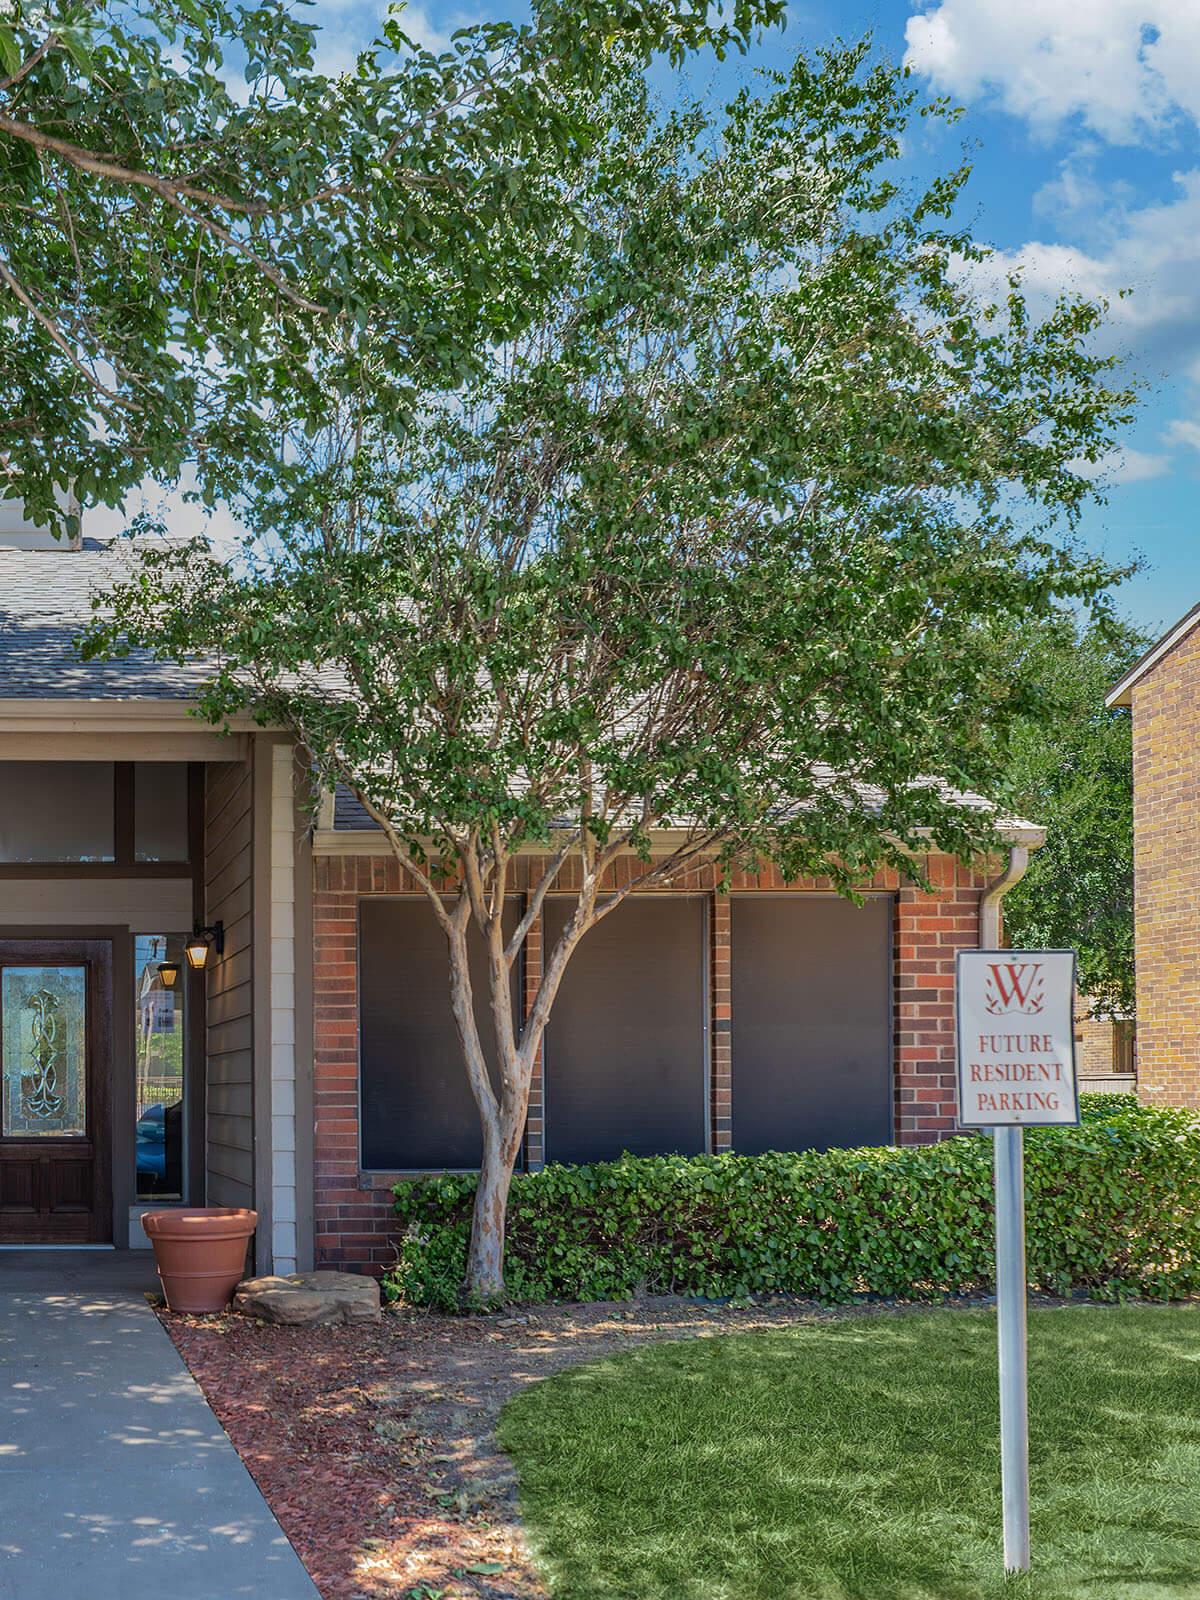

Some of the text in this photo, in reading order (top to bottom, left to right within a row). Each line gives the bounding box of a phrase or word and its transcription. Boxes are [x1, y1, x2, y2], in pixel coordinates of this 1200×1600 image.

[987, 964, 1043, 1008] W
[979, 1035, 1053, 1053] FUTURE
[970, 1064, 1063, 1082] RESIDENT
[977, 1093, 1059, 1111] PARKING
